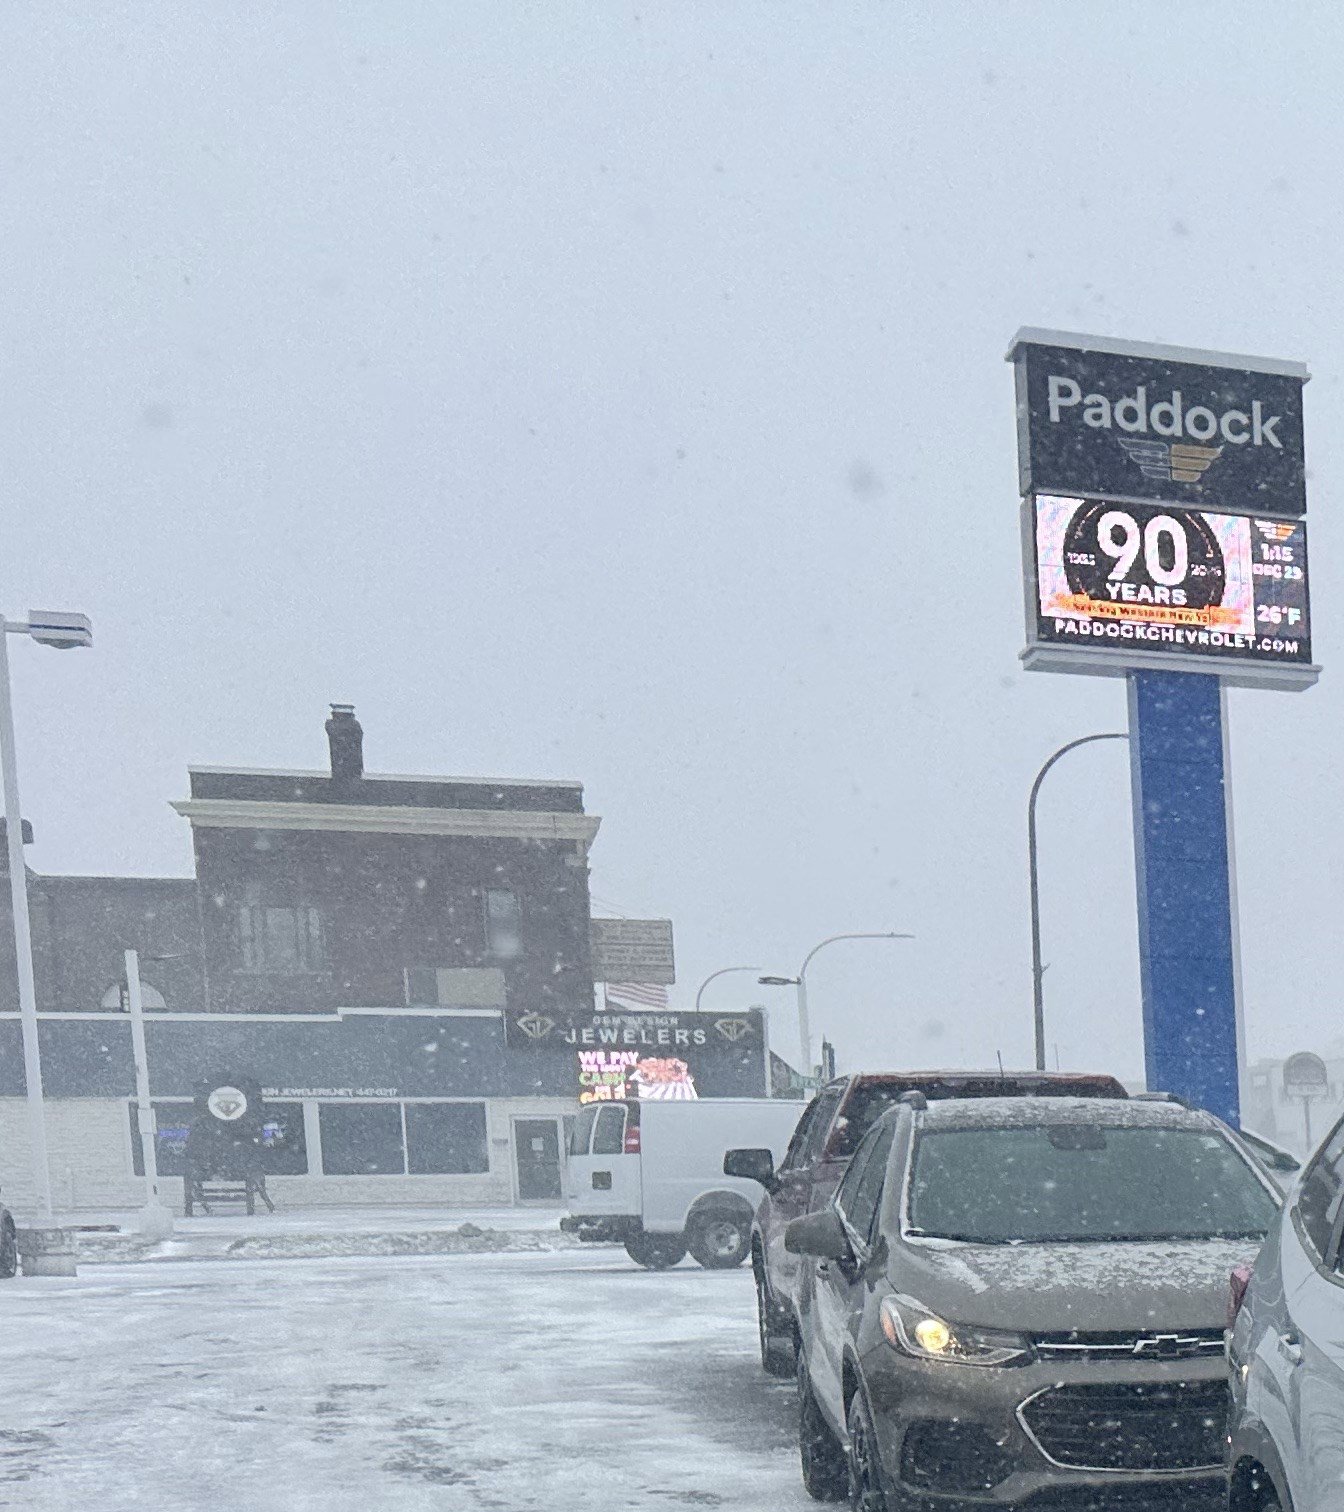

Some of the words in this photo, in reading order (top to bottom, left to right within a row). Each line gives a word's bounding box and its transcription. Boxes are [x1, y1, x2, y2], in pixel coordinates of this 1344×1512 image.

[1047, 375, 1284, 449] Paddock
[1096, 510, 1189, 586] 90
[1105, 583, 1188, 606] YEARS
[1055, 619, 1300, 654] PADDOCKCHEVROLET.COM
[564, 1028, 707, 1046] JEWELERS
[610, 1051, 639, 1065] PAY
